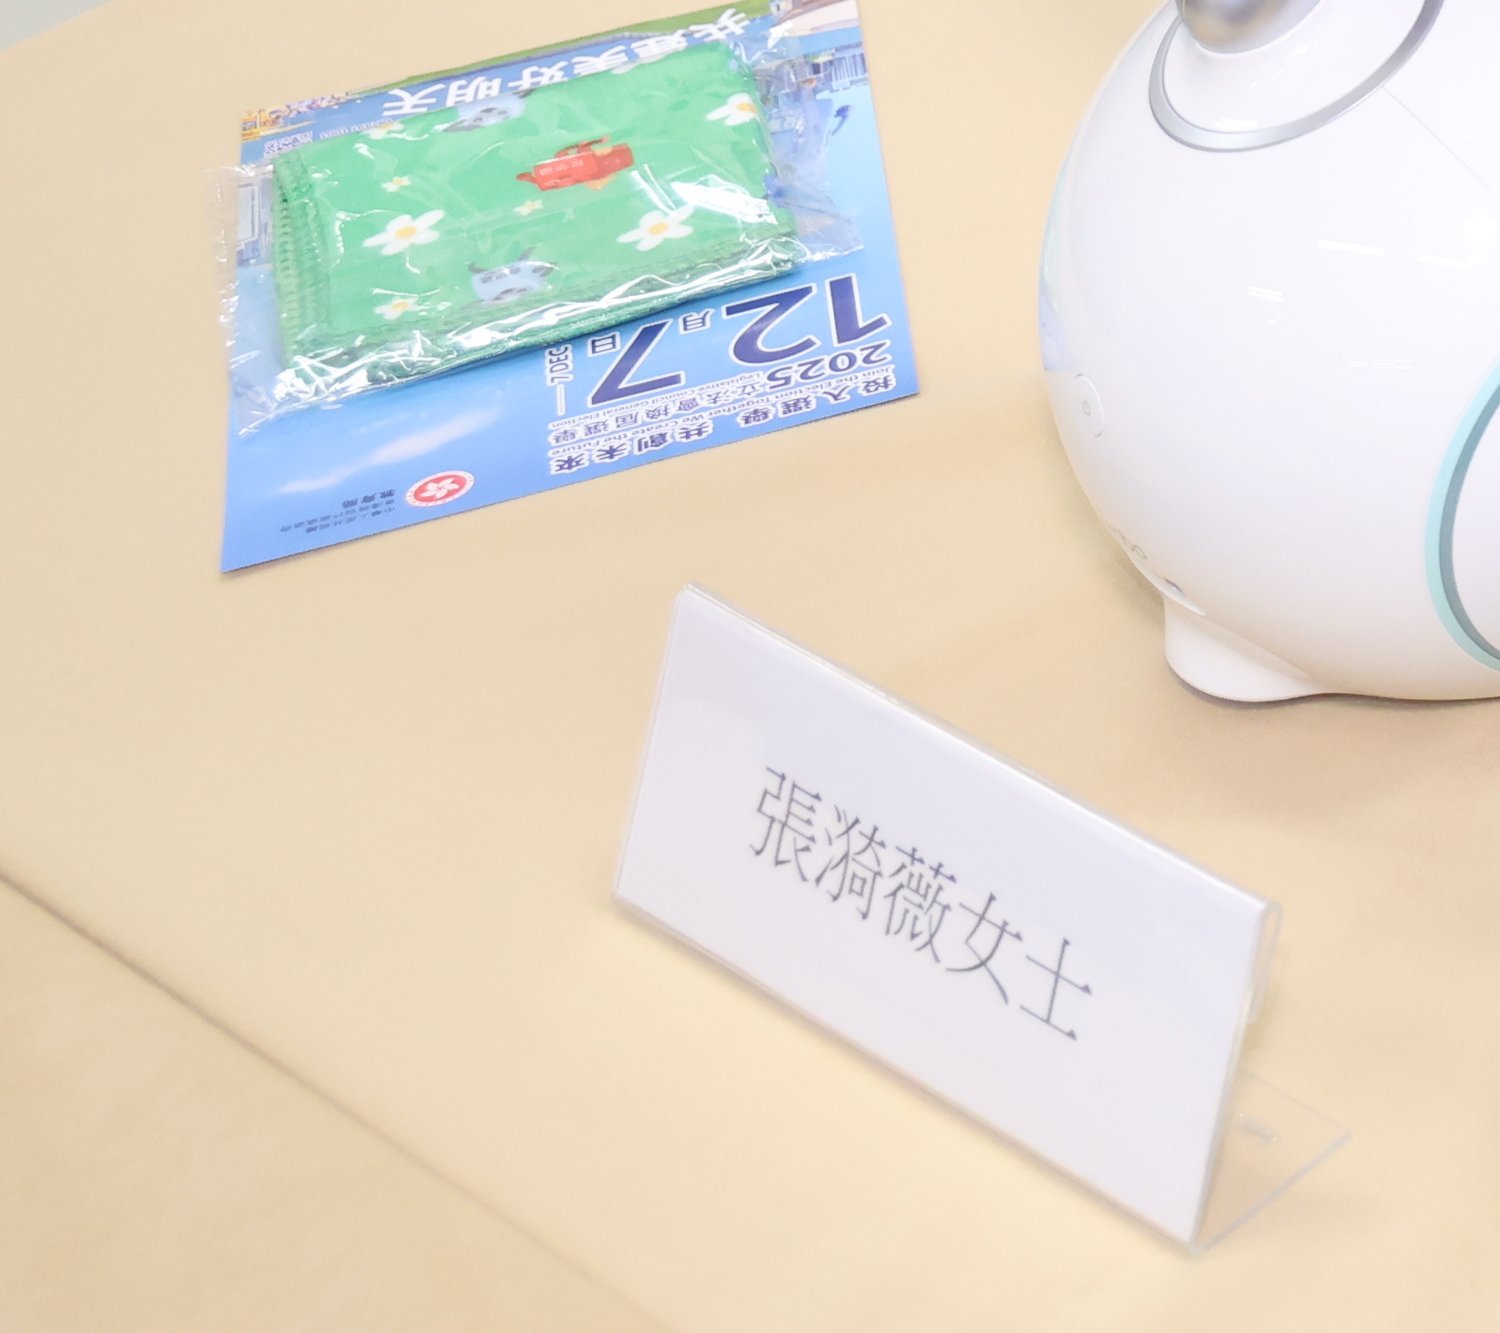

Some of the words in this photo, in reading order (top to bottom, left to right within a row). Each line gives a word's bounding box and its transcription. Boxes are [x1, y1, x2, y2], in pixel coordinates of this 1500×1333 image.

[765, 341, 889, 390] 2025
[862, 366, 892, 379] Join
[838, 373, 859, 384] the
[650, 387, 696, 404] Council
[774, 380, 833, 400] Election
[708, 395, 771, 416] Together
[740, 373, 894, 426] 投入選舉
[553, 382, 761, 444] 立法會換屆選舉
[603, 400, 650, 416] General
[552, 413, 602, 428] Election
[681, 413, 704, 424] We
[631, 419, 679, 435] Create
[554, 420, 712, 473] 共創未來
[603, 433, 628, 444] the
[551, 441, 600, 455] Future
[750, 765, 1093, 1043] 張漪薇女士
